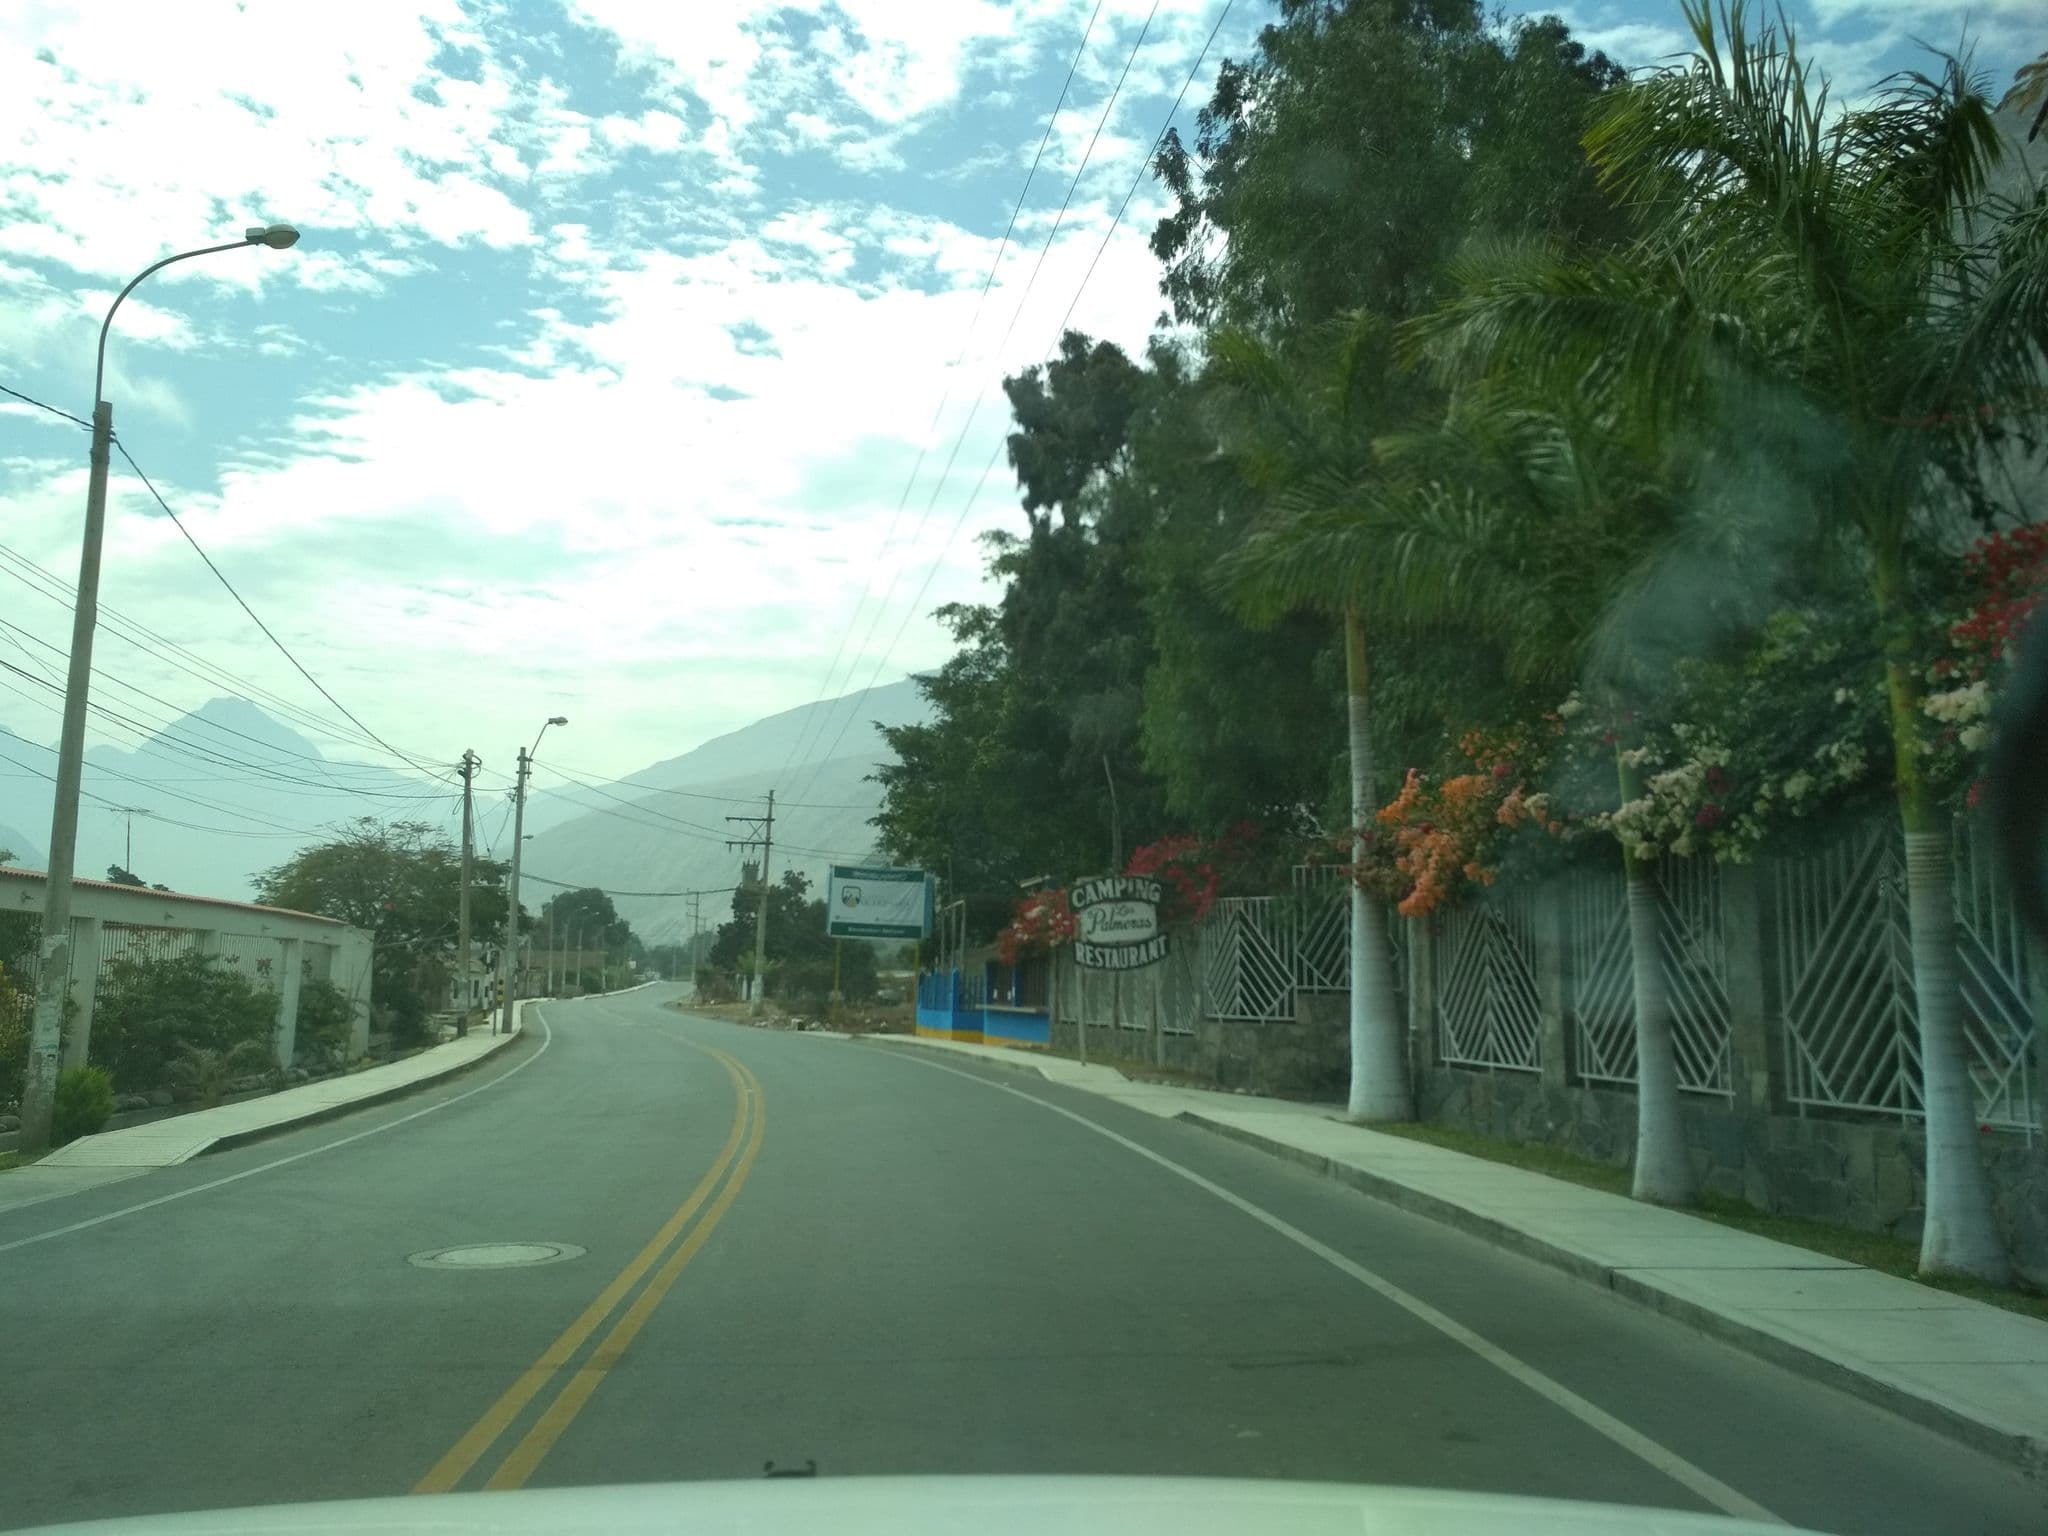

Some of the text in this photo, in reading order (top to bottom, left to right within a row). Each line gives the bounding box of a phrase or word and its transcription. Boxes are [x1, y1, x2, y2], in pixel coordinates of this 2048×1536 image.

[1072, 879, 1161, 908] CAMPING
[1087, 908, 1153, 934] Palmeras
[1075, 935, 1168, 969] RESTAURANT
